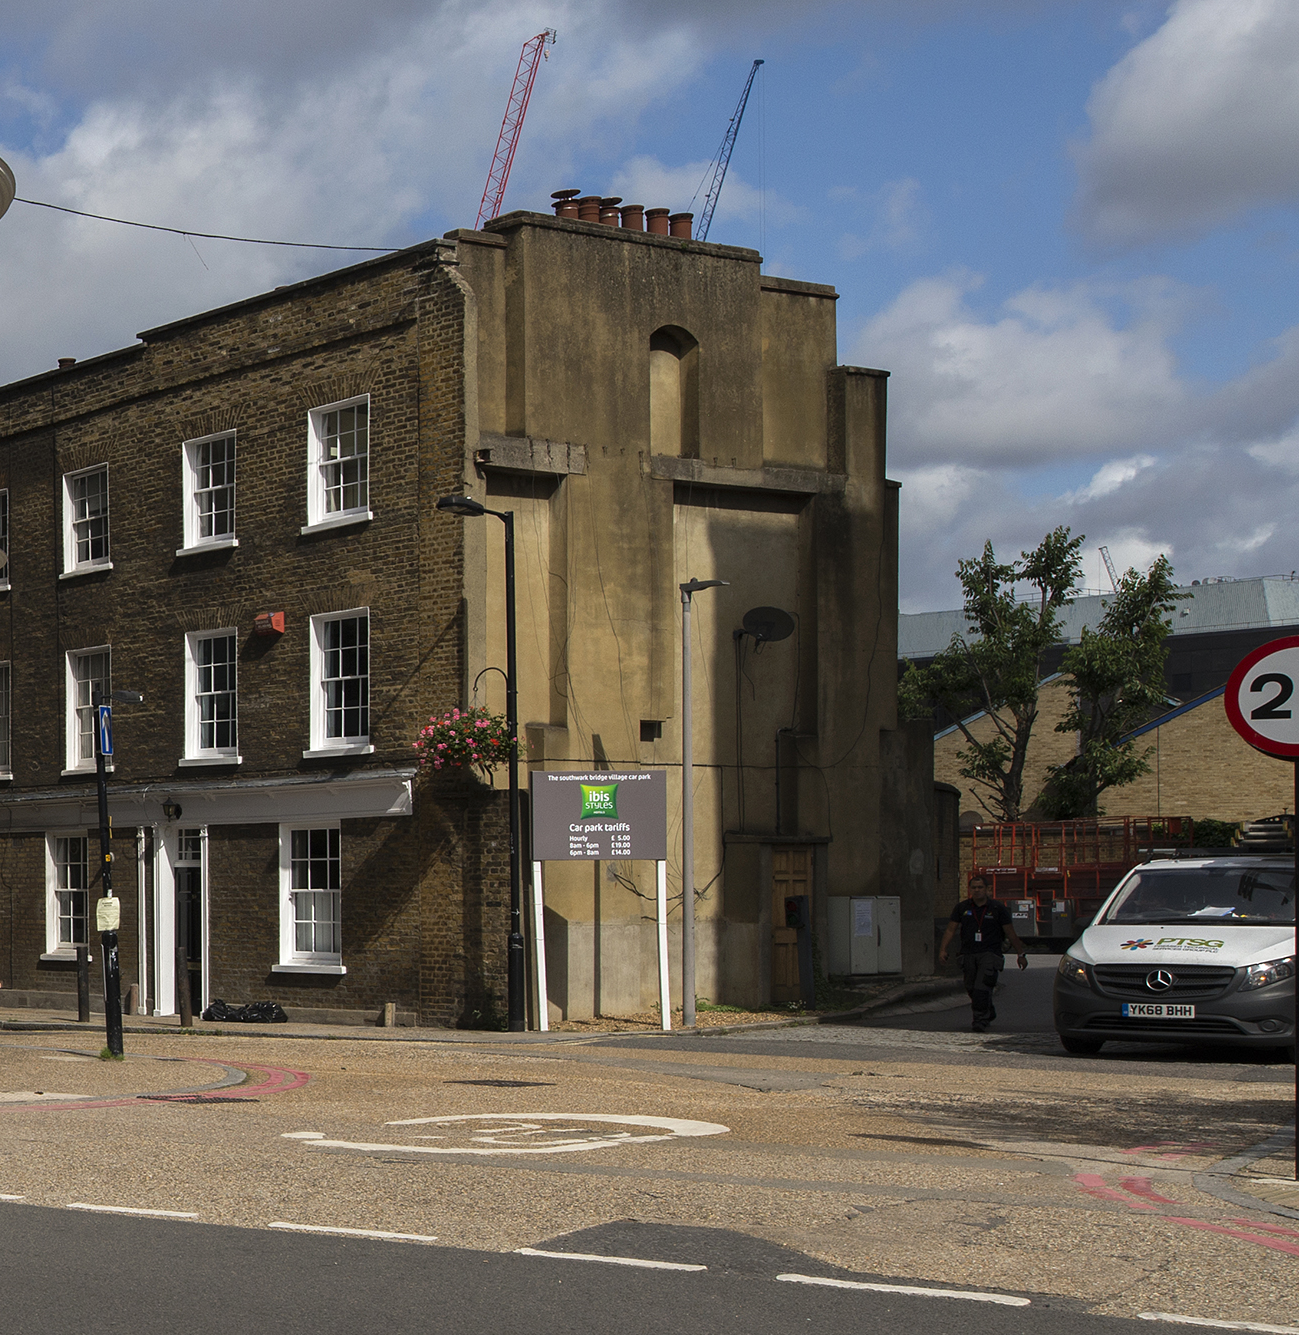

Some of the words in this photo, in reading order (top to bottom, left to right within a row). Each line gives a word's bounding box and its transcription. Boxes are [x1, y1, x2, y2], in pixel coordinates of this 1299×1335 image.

[589, 774, 607, 782] bridge
[589, 791, 609, 802] ibis
[569, 824, 583, 832] Car
[585, 824, 603, 833] park
[605, 823, 630, 831] tariffs
[1157, 938, 1224, 948] PTSG
[1130, 1005, 1162, 1015] YK68
[1166, 1006, 1192, 1016] BHH
